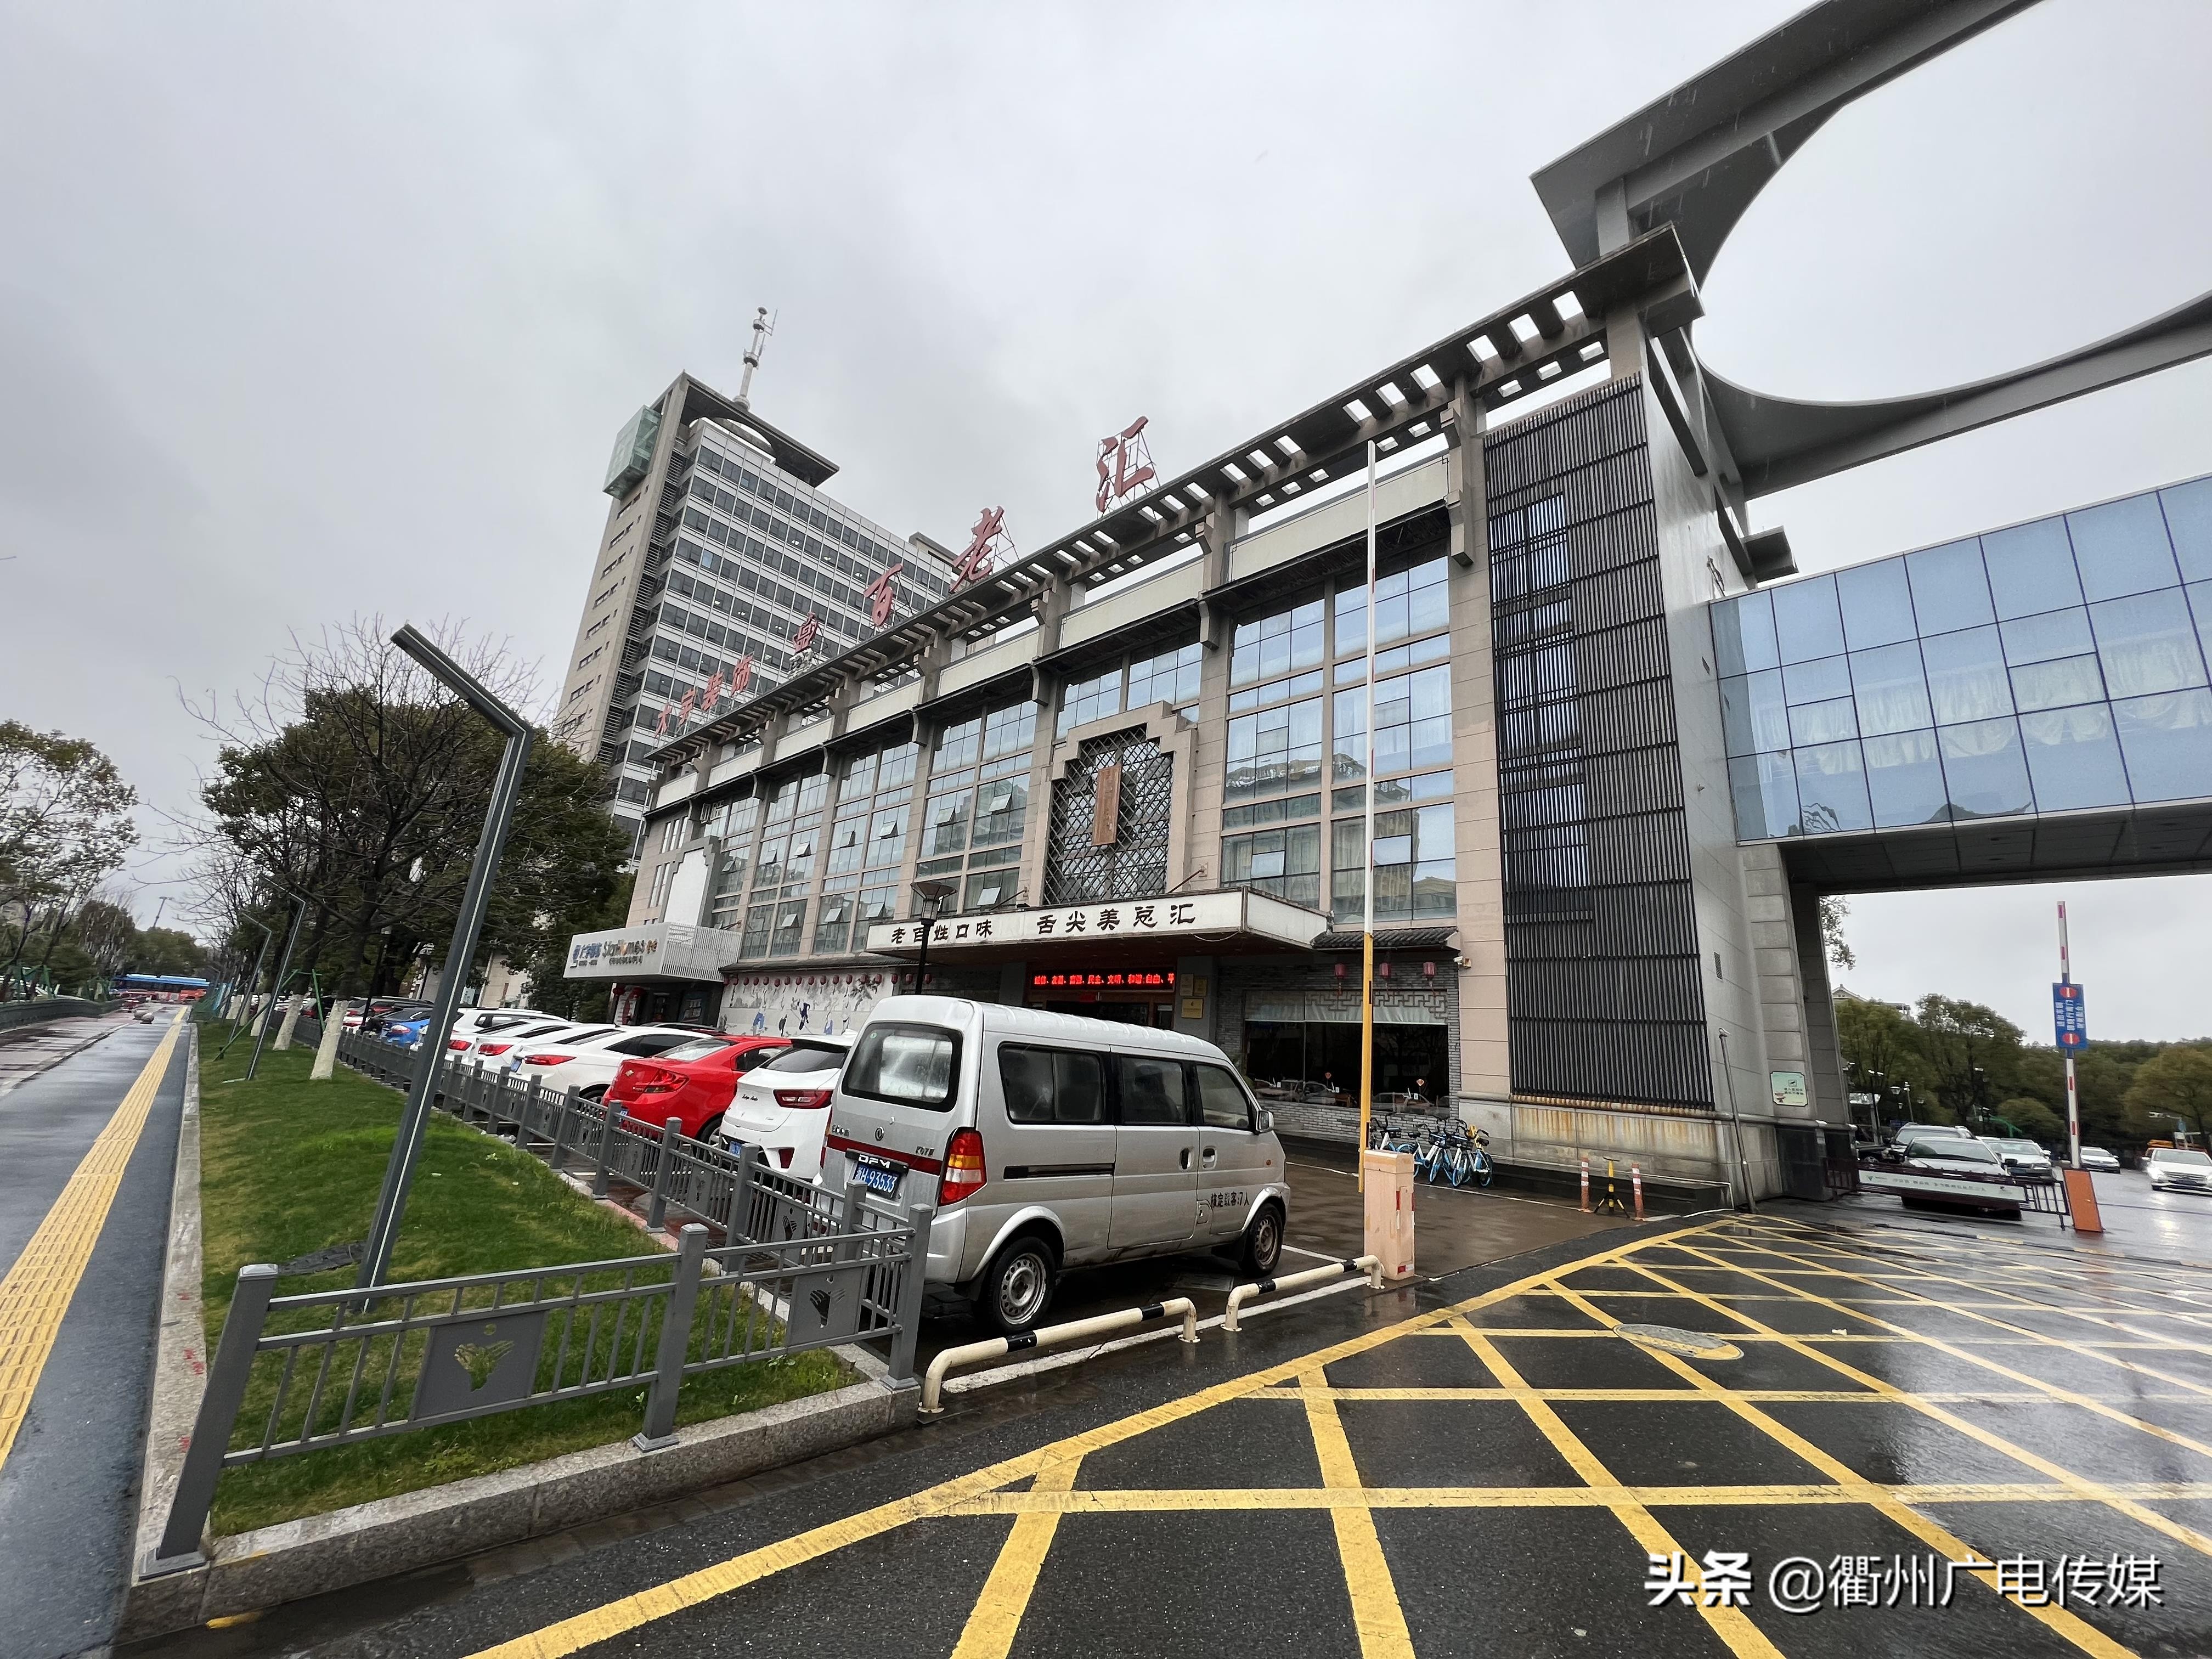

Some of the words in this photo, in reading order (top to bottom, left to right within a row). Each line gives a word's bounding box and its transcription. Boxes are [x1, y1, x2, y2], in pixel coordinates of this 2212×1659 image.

[891, 919, 992, 944] 老百姓口味
[859, 1155, 890, 1169] DFM
